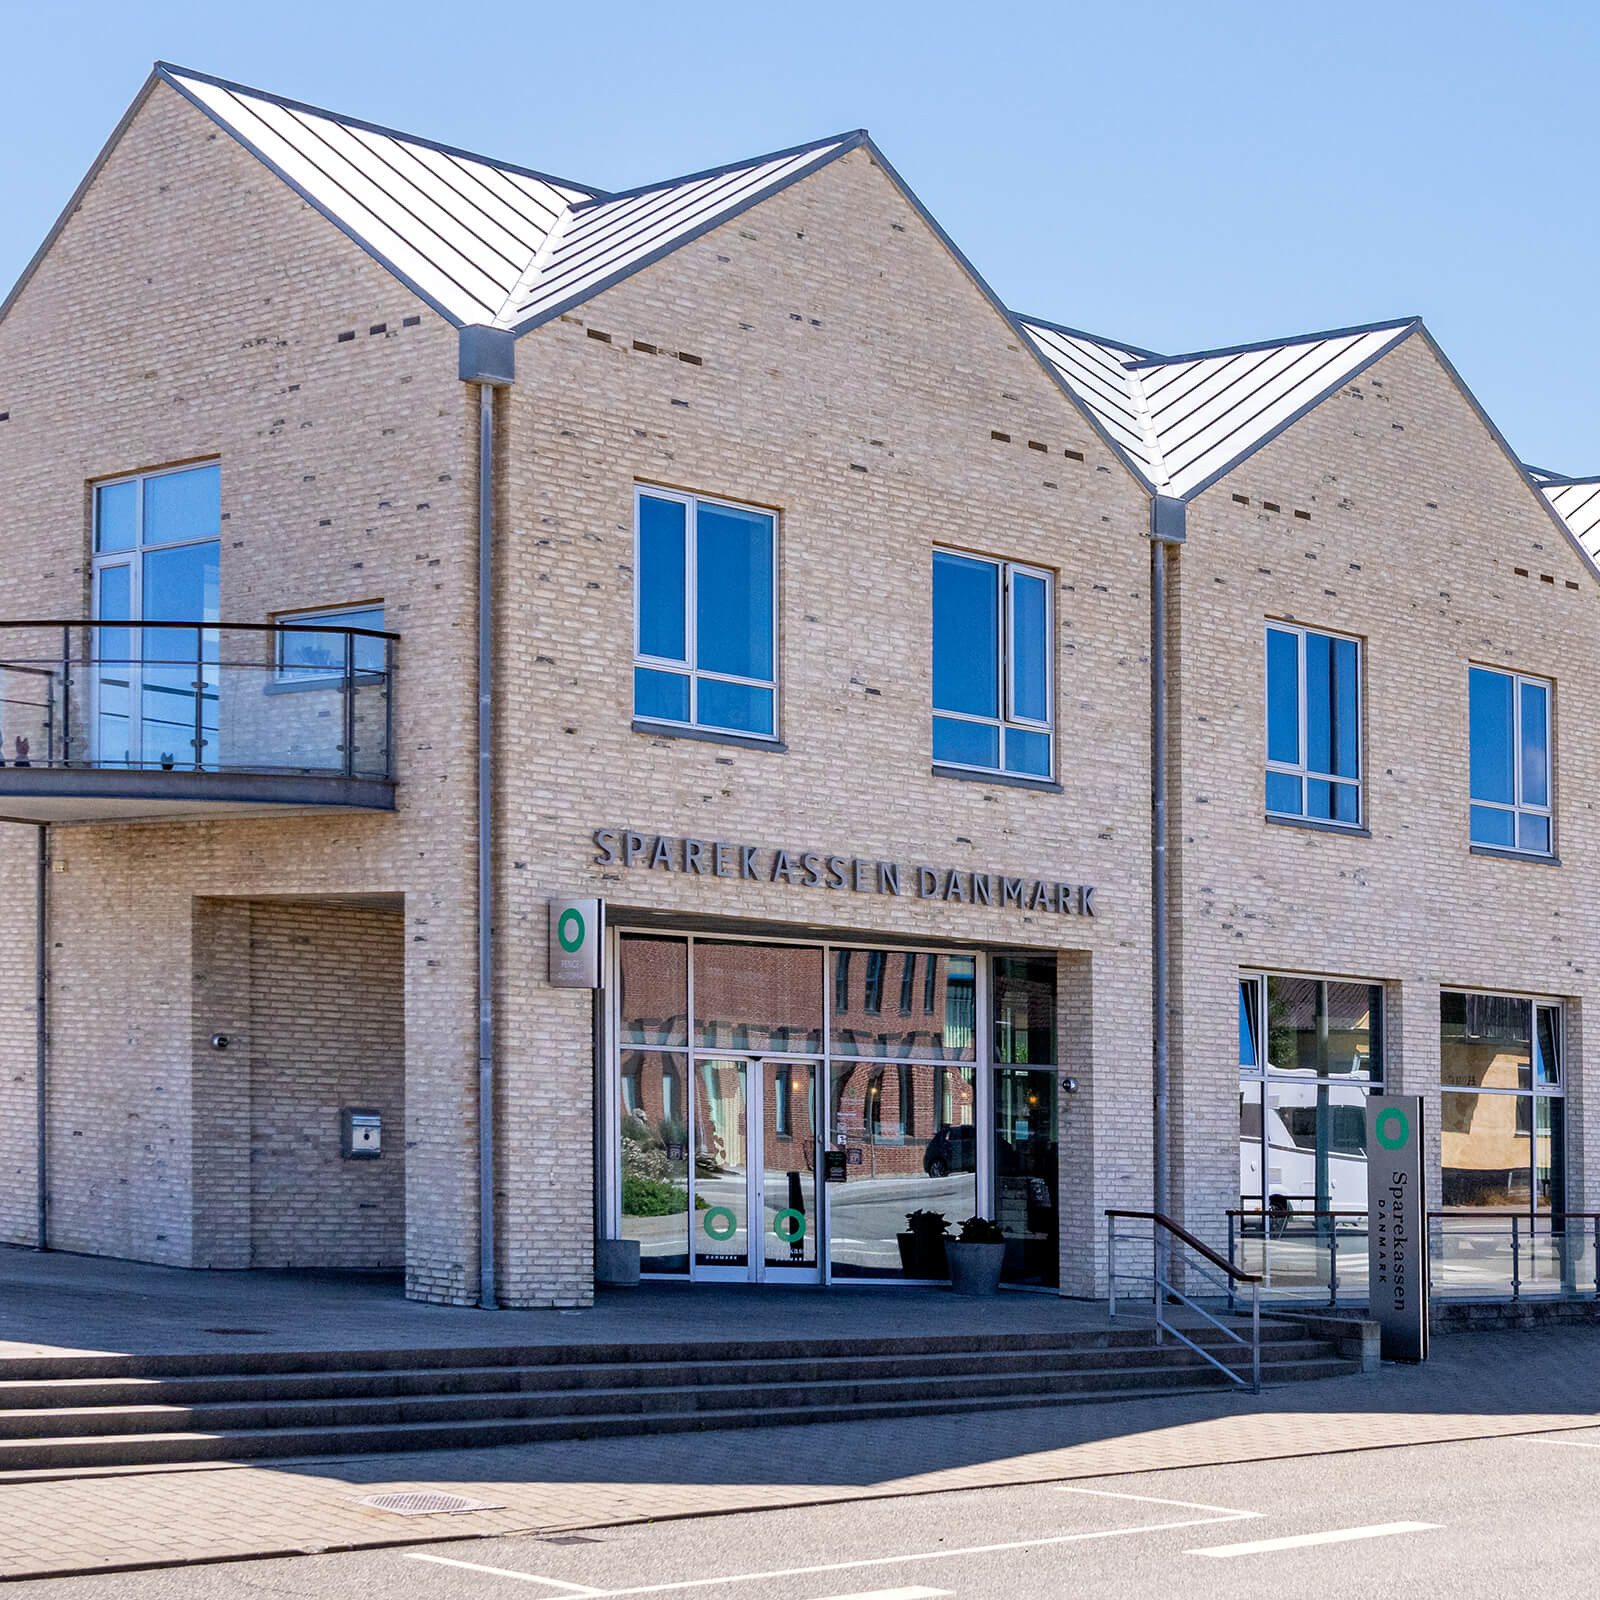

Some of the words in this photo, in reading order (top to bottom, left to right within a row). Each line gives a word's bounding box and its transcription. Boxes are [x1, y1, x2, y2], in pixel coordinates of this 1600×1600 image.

[593, 829, 901, 896] SPAREKASSEN
[917, 864, 1097, 917] DANMARK
[1377, 1199, 1388, 1284] DANMARK
[1388, 1170, 1409, 1312] Sparekassen
